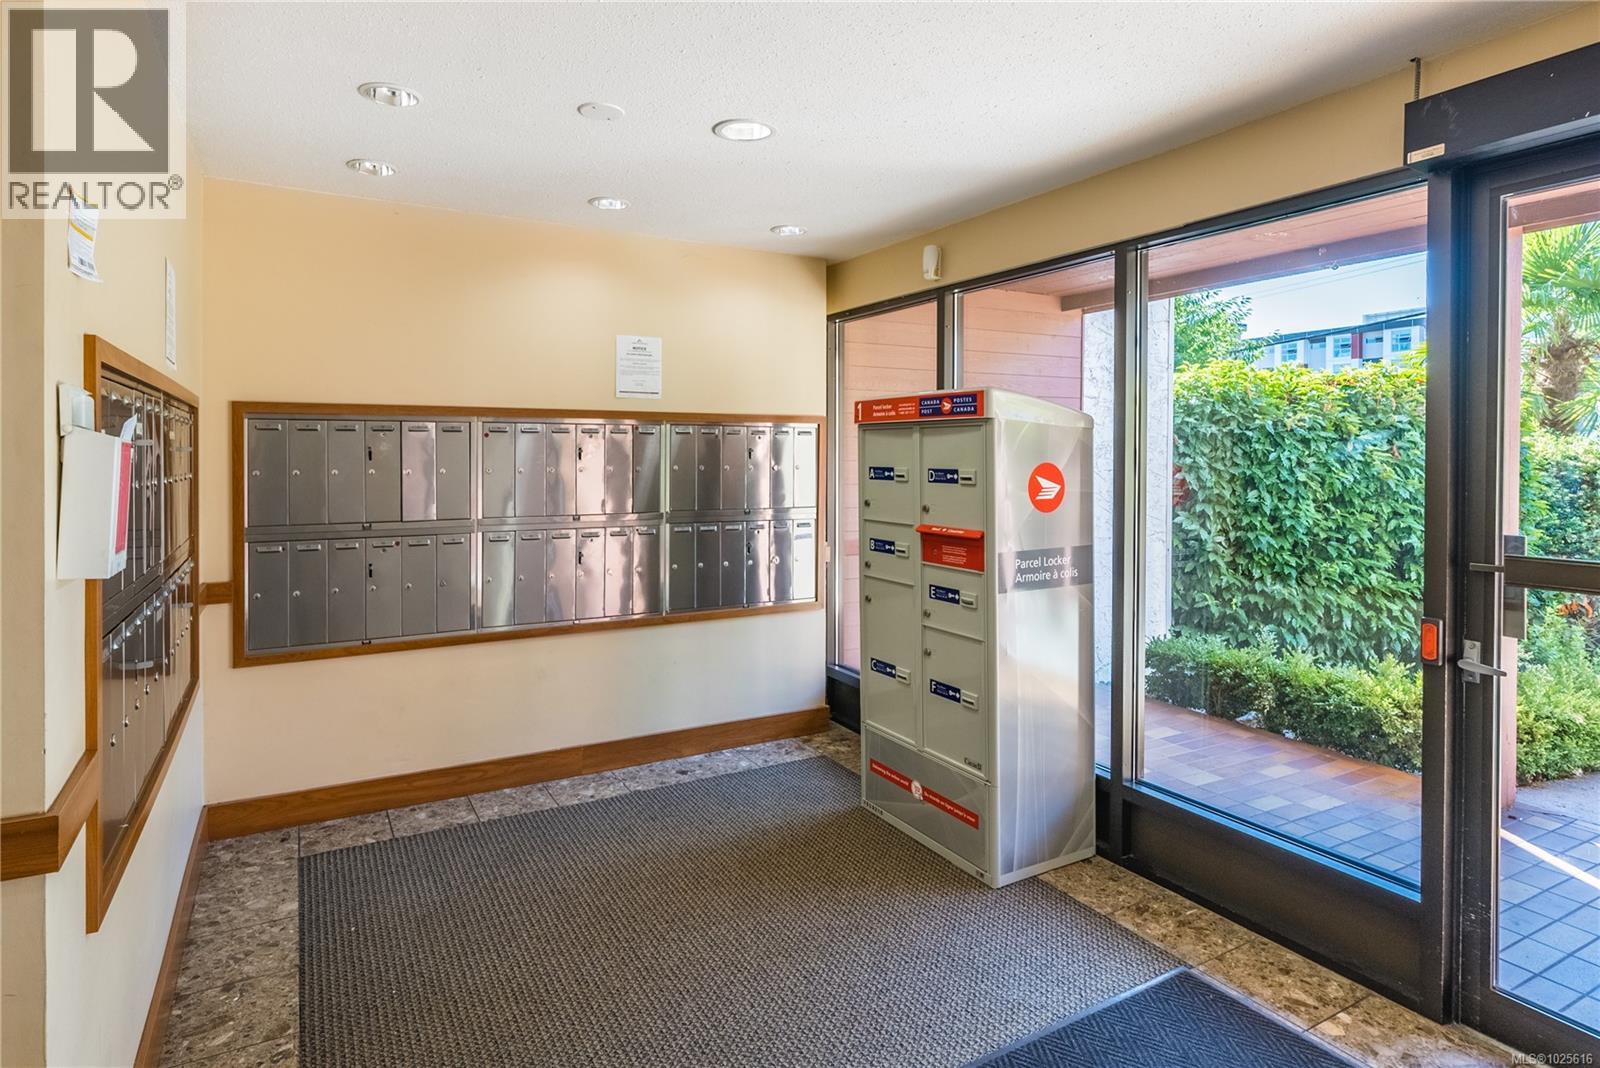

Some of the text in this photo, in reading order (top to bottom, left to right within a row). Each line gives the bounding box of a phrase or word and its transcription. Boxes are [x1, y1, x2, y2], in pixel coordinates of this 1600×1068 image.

[869, 468, 875, 479] A
[928, 470, 936, 482] D
[870, 539, 875, 550] B
[1015, 555, 1071, 569] Parcel Locker
[1015, 566, 1079, 583] Armoire à colis
[930, 586, 936, 598] E
[871, 660, 877, 670] C
[931, 681, 937, 692] F
